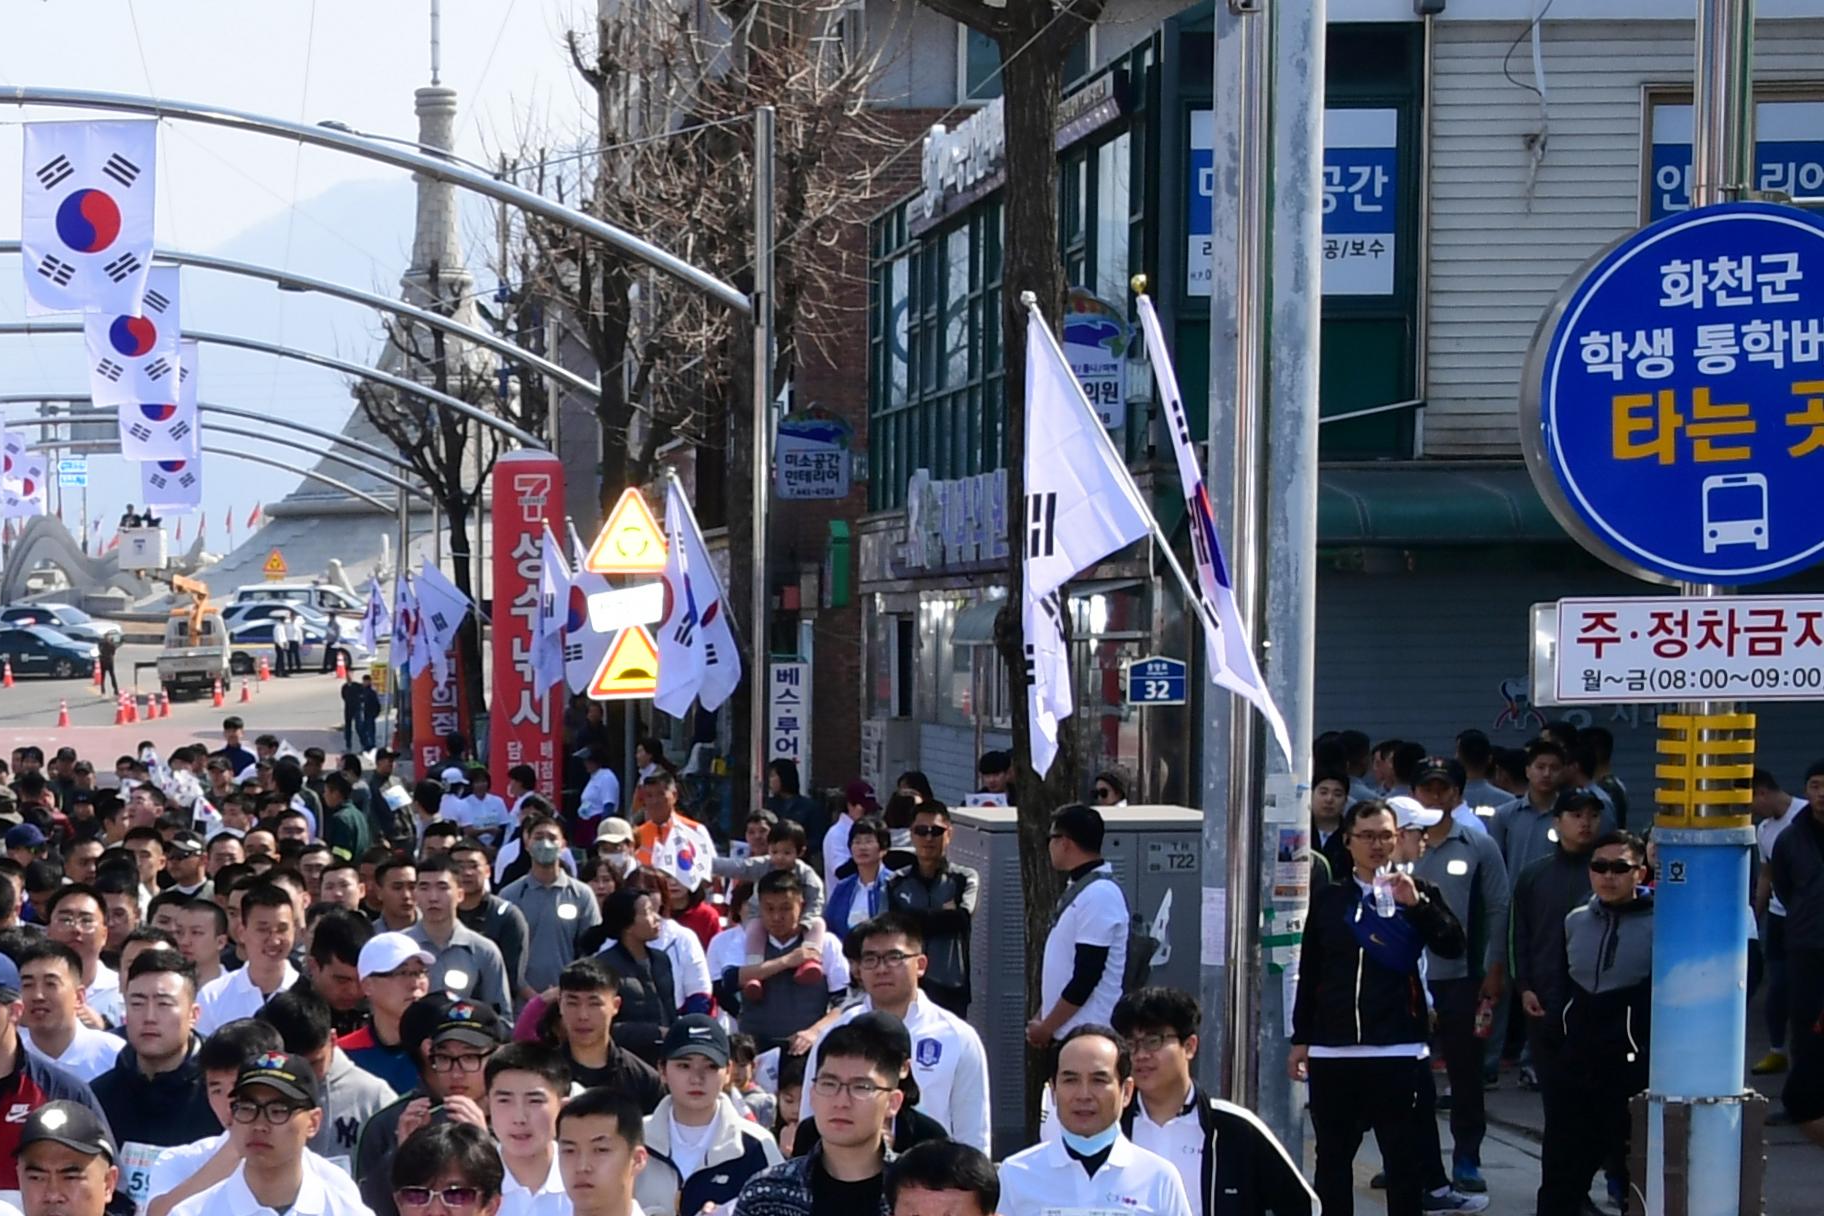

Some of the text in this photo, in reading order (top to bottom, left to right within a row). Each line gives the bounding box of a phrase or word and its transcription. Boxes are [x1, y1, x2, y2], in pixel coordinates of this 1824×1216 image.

[1660, 253, 1803, 309] 화천군
[1580, 328, 1674, 381] 학생
[1612, 387, 1756, 465] 타는
[784, 453, 841, 470] 미소공간
[784, 469, 840, 487] 인테리어
[1143, 680, 1170, 700] 32
[1167, 853, 1195, 869] T22
